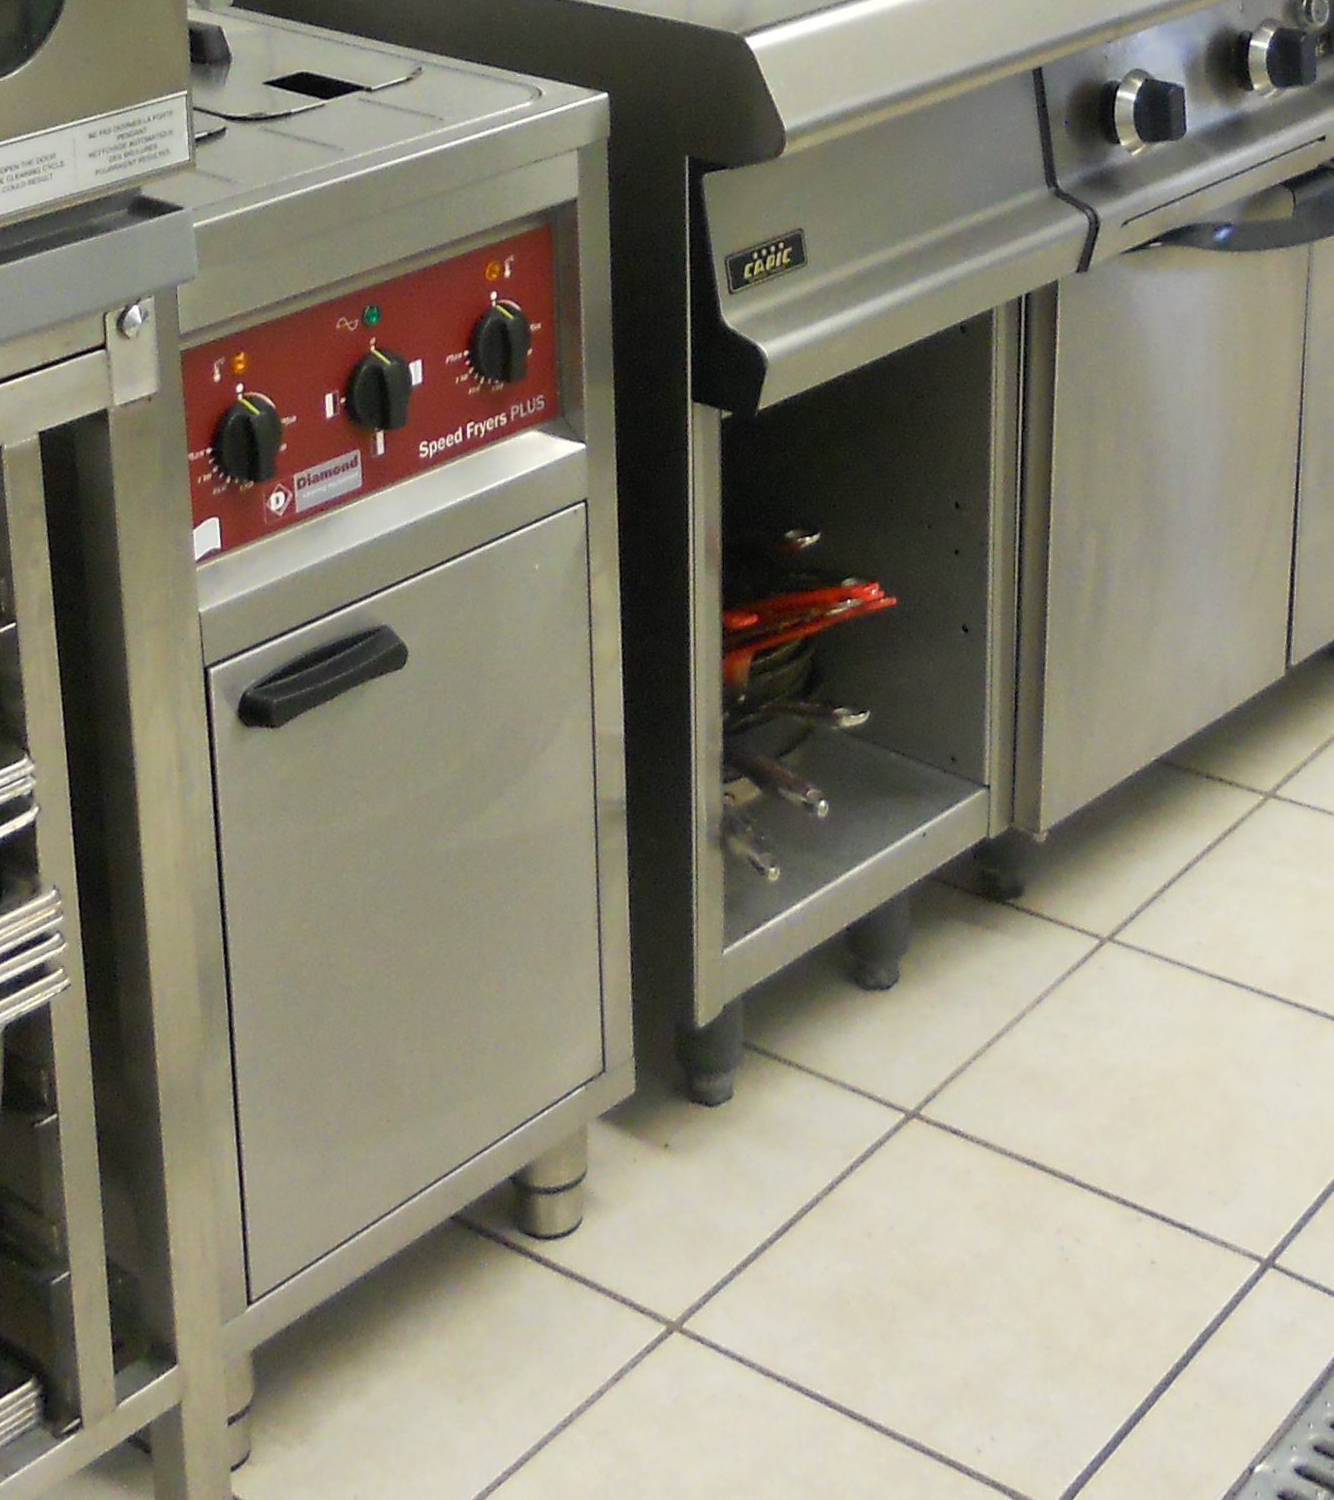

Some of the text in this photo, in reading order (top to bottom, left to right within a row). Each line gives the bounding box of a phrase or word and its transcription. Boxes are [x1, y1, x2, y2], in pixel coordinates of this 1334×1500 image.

[418, 394, 546, 459] Speed Fryers PLUS
[297, 455, 359, 490] Diamond
